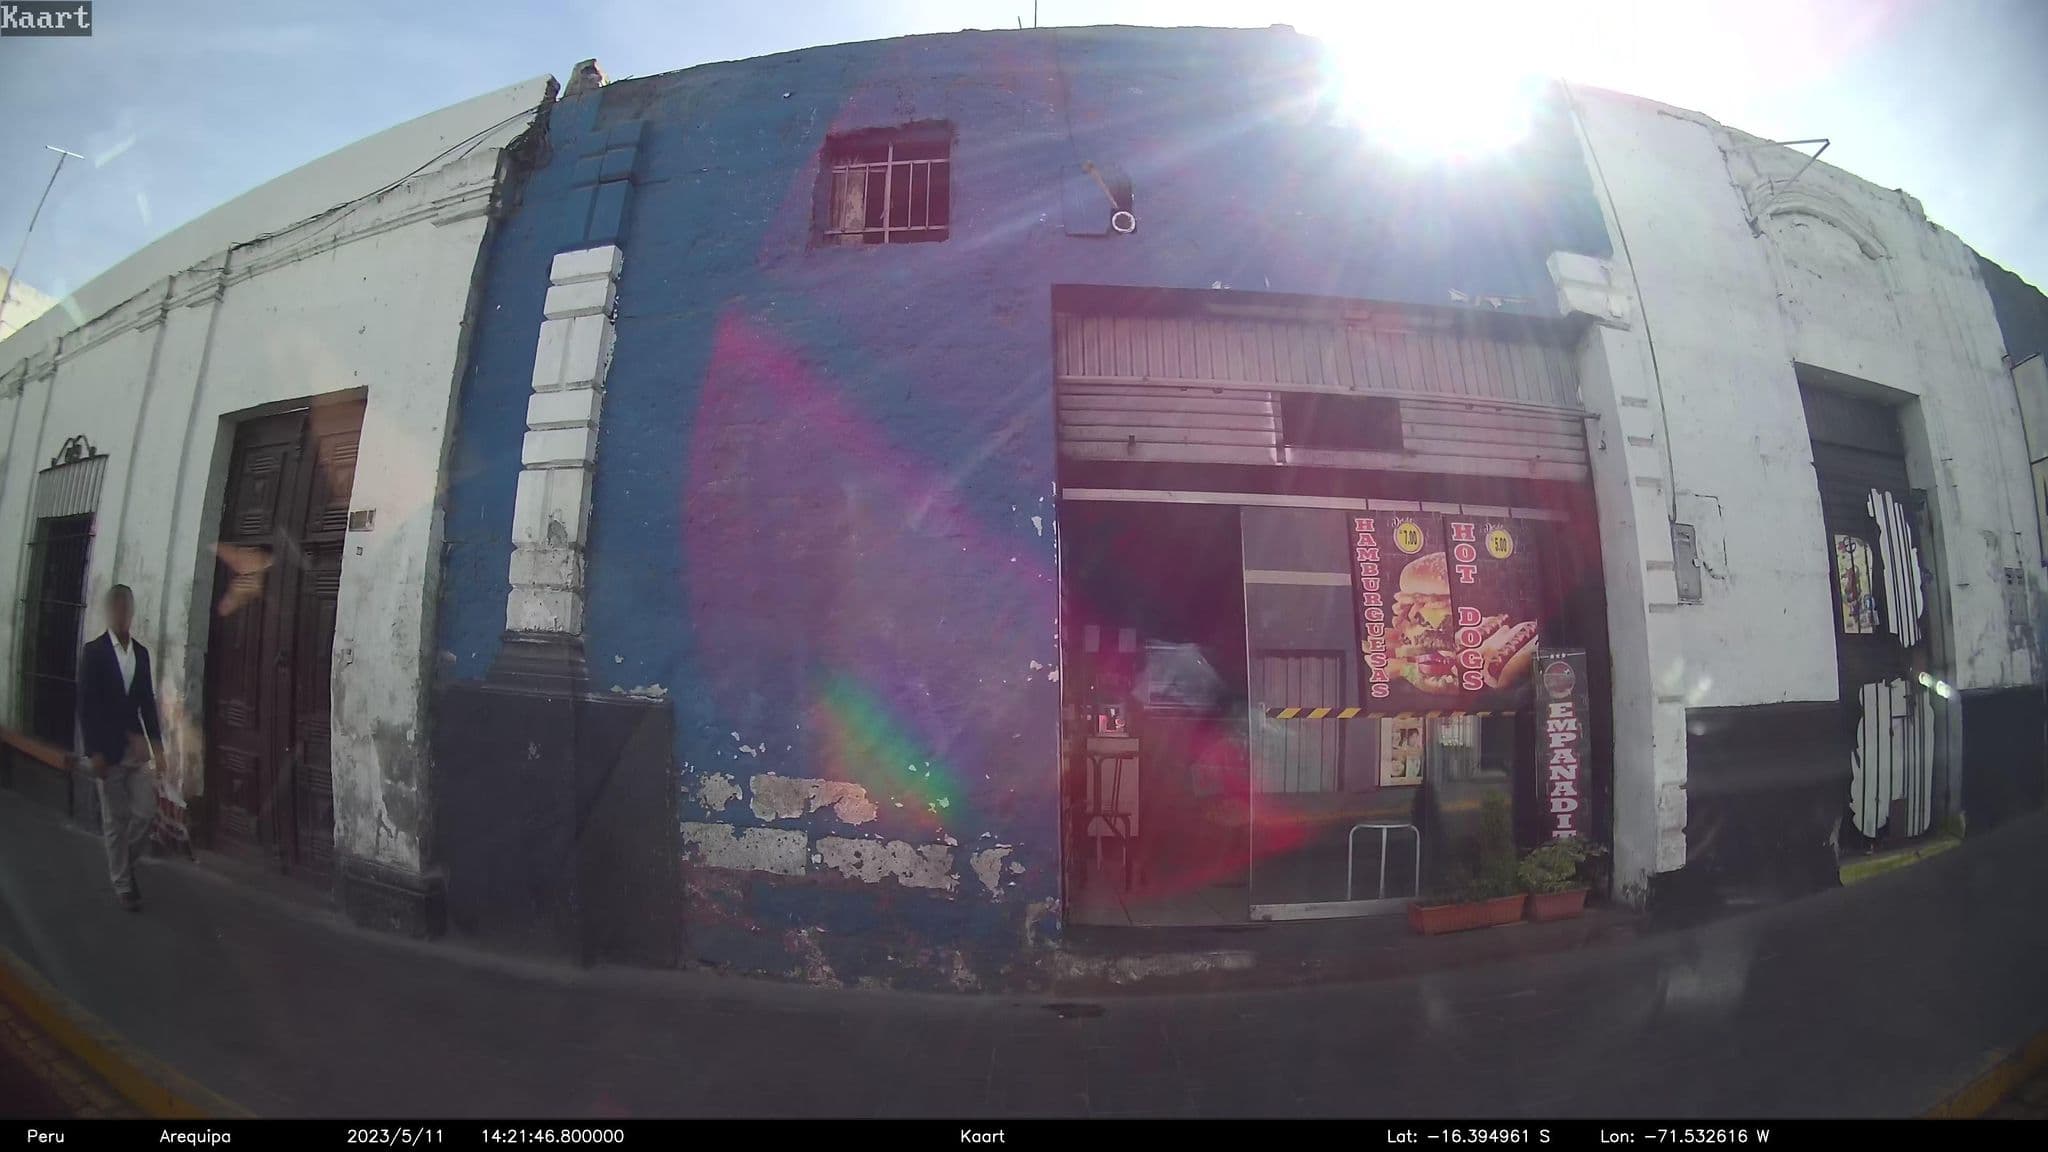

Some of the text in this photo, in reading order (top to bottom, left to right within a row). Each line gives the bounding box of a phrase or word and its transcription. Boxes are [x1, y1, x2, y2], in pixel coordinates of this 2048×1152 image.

[1354, 518, 1390, 698] HAMBURGUESAS
[1451, 522, 1484, 690] HOT DOGS
